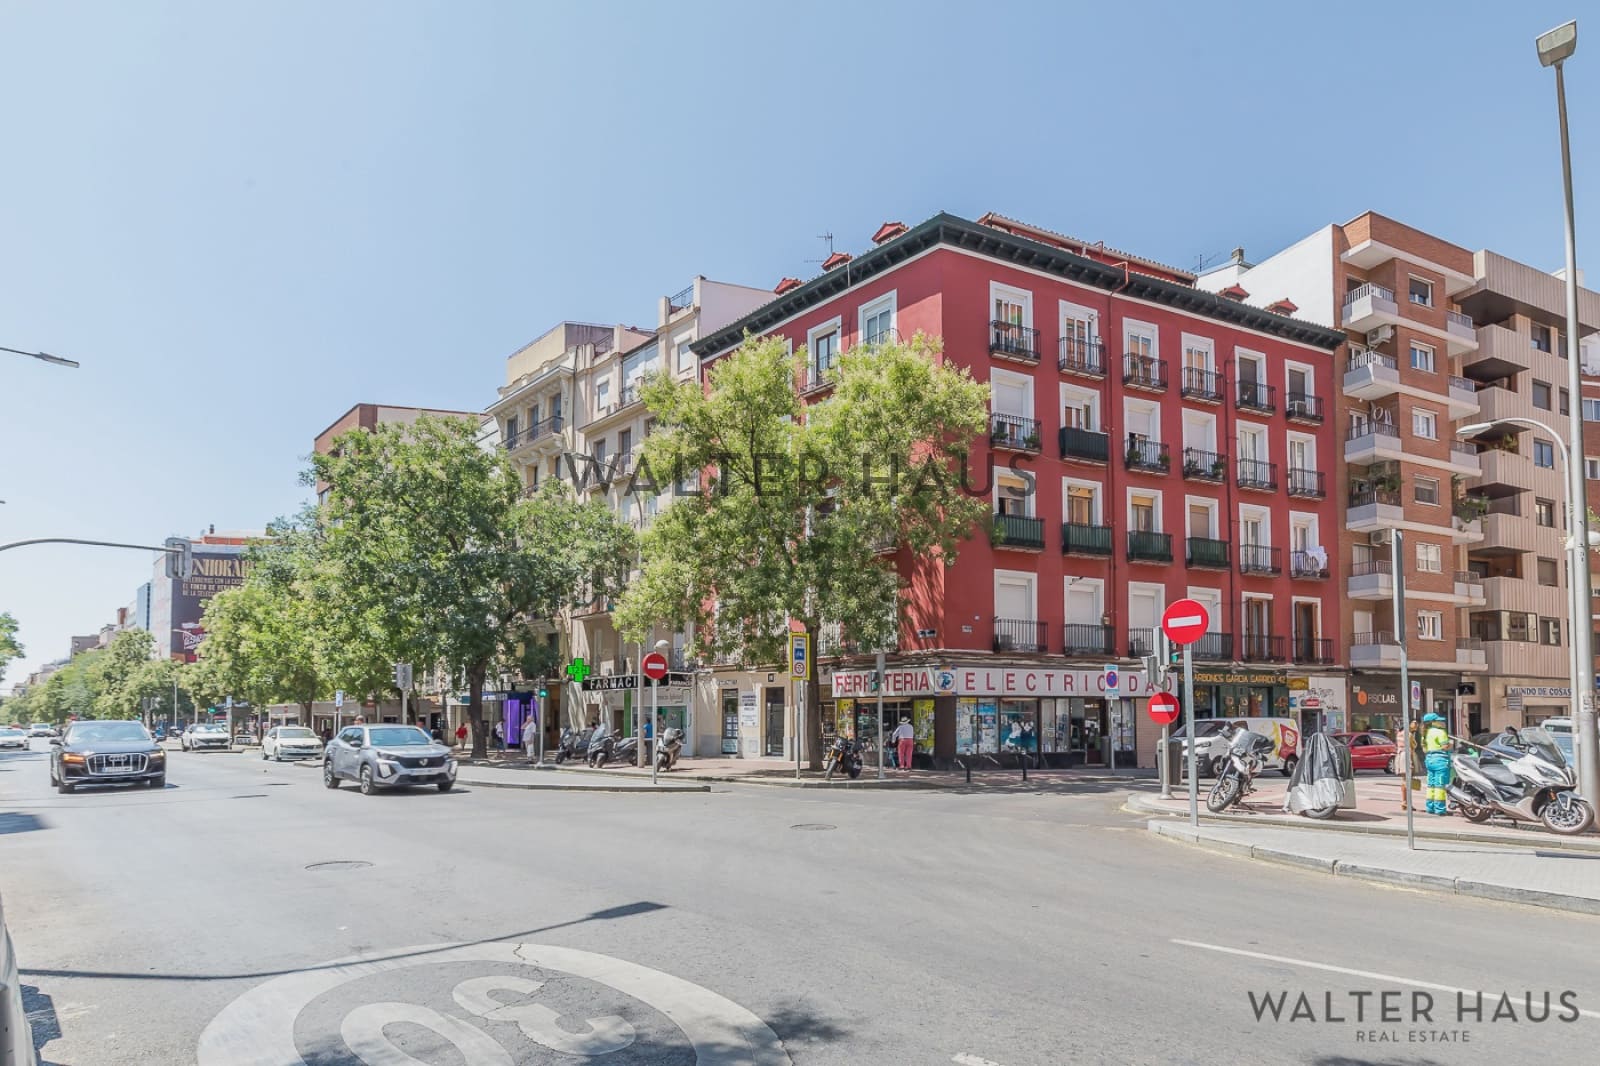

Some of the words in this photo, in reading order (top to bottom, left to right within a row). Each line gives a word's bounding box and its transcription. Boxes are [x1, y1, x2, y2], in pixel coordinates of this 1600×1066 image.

[589, 676, 659, 690] FARMACI
[835, 672, 929, 693] FERRTERIA
[964, 672, 1173, 693] ELECTRICDAD
